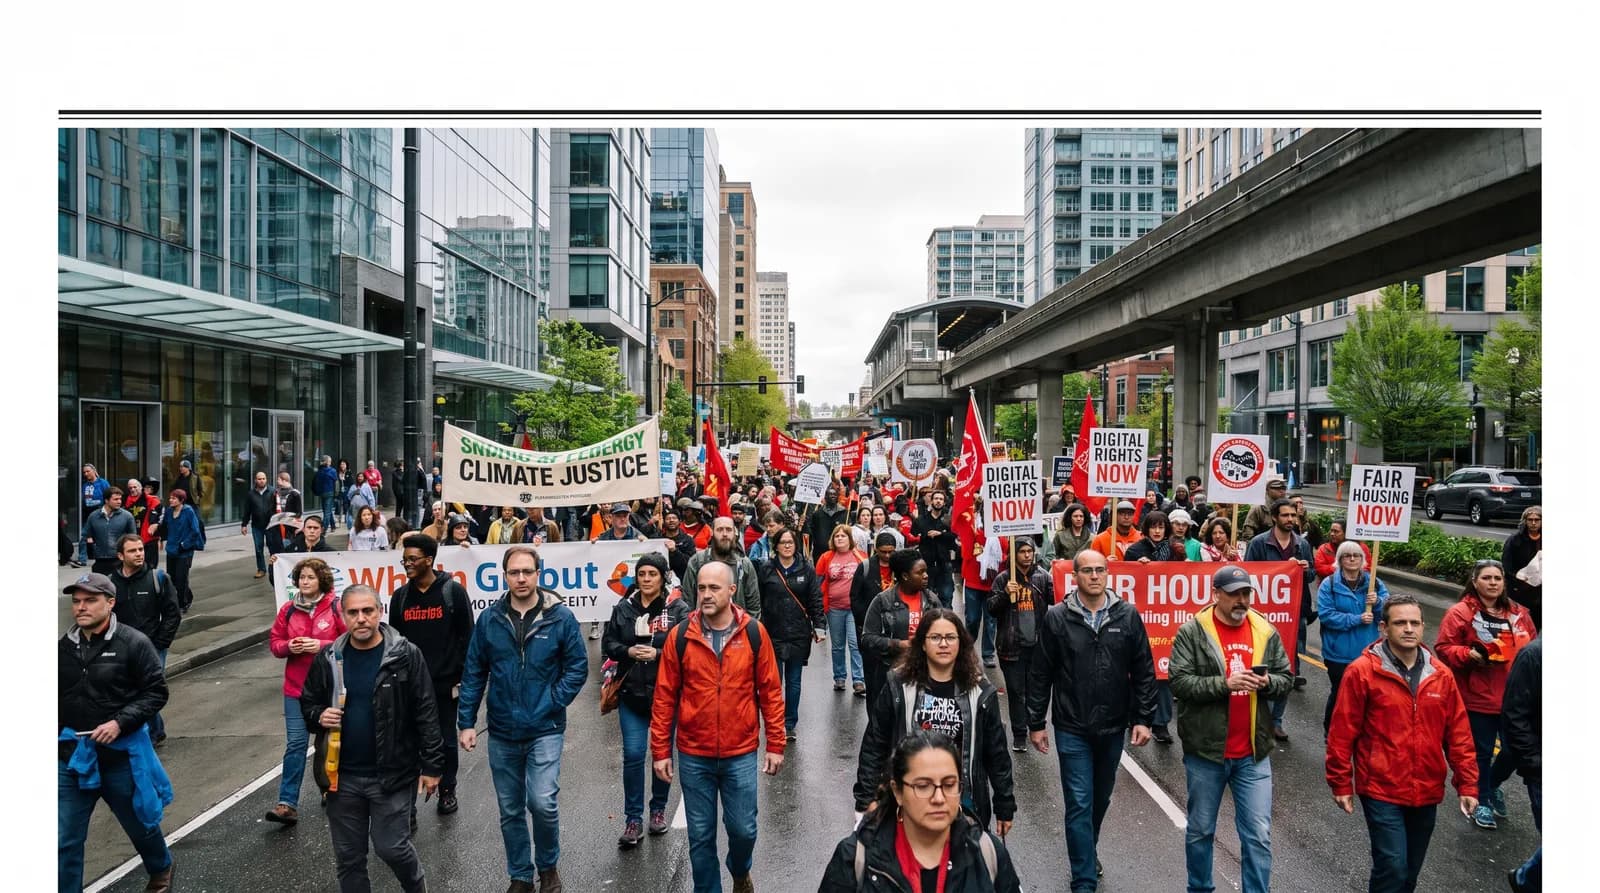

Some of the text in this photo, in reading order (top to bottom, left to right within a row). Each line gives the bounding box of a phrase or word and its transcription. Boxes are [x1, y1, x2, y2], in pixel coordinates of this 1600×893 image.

[1094, 432, 1144, 447] DIGITAL
[1095, 448, 1142, 463] RIGHTS
[460, 458, 554, 486] CLIMATE
[560, 453, 649, 486] JUSTICE
[986, 465, 1038, 482] DIGITAL
[1097, 464, 1139, 484] NOW
[1363, 469, 1402, 488] FAIR
[989, 482, 1037, 499] RIGHTS
[1353, 488, 1409, 504] HOUSING
[992, 499, 1035, 522] NOW
[1356, 504, 1403, 527] NOW
[1147, 573, 1291, 605] HOUNG
